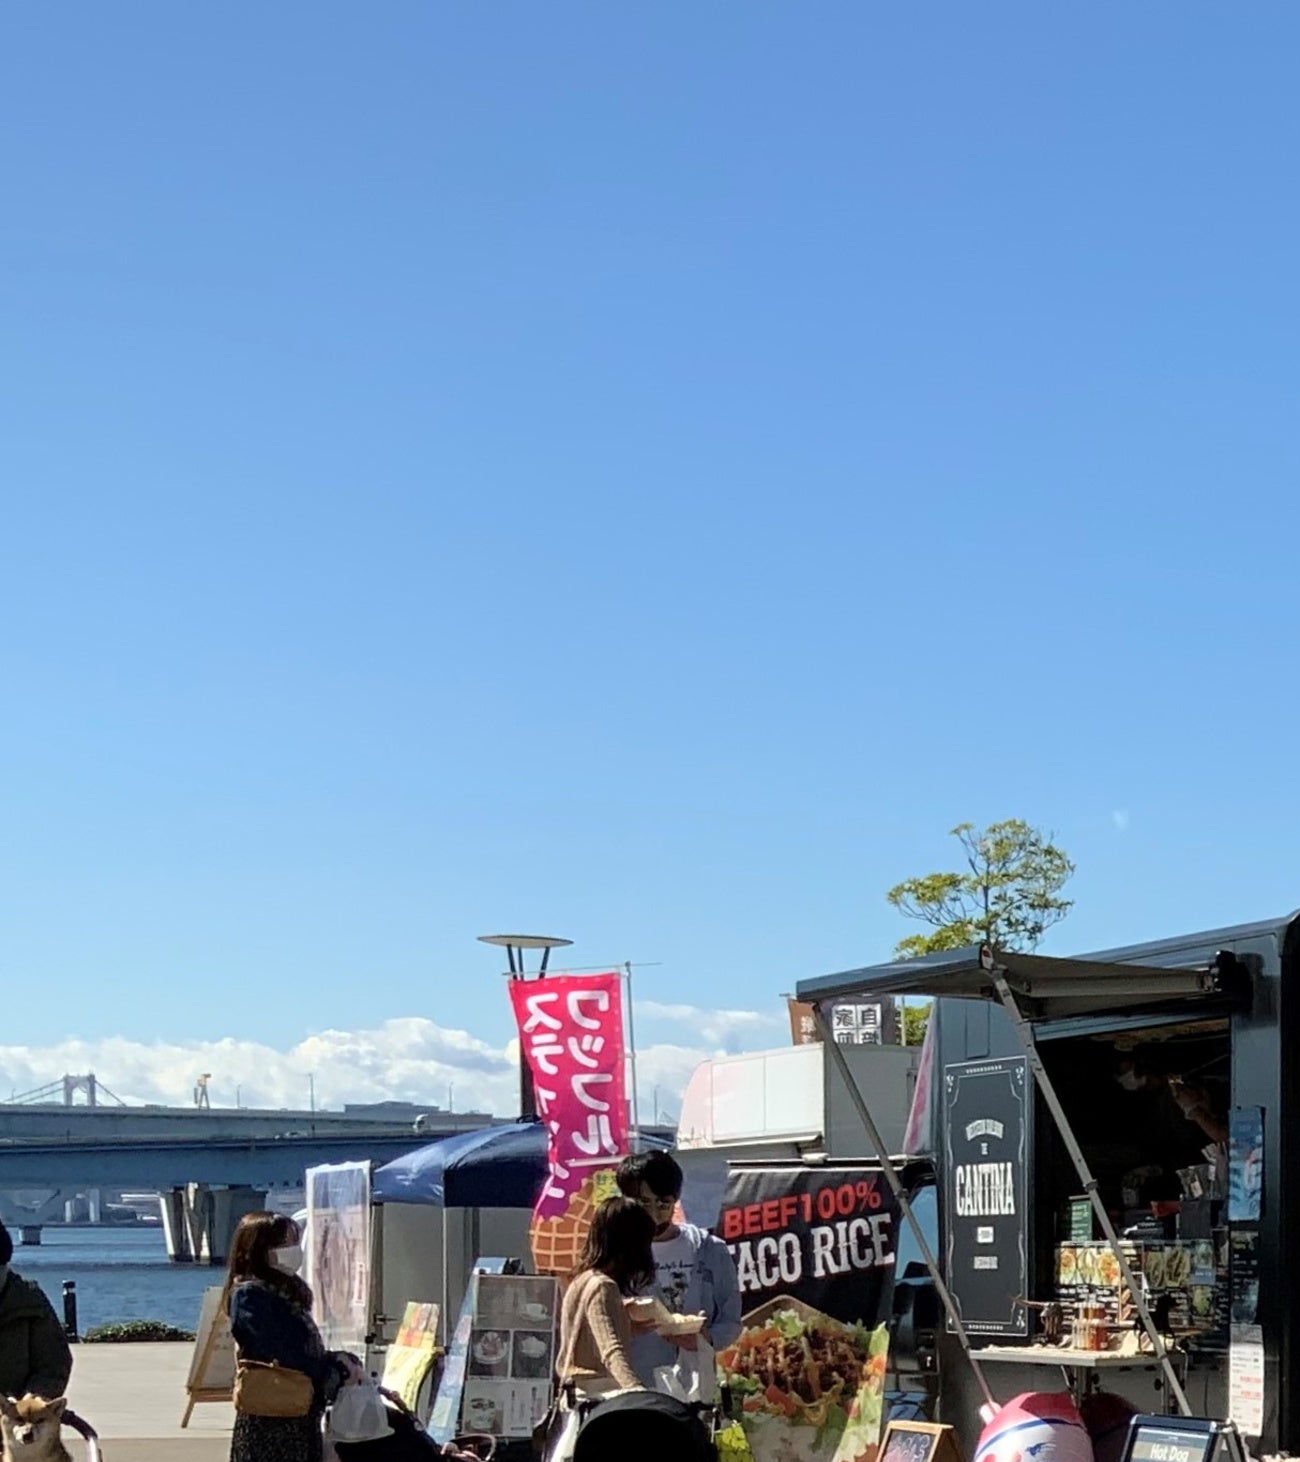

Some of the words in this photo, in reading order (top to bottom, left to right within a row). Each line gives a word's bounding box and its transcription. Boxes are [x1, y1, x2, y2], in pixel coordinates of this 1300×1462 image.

[956, 1162, 1015, 1216] CANTINA
[811, 1213, 896, 1278] RICE
[1150, 1444, 1168, 1460] Hot
